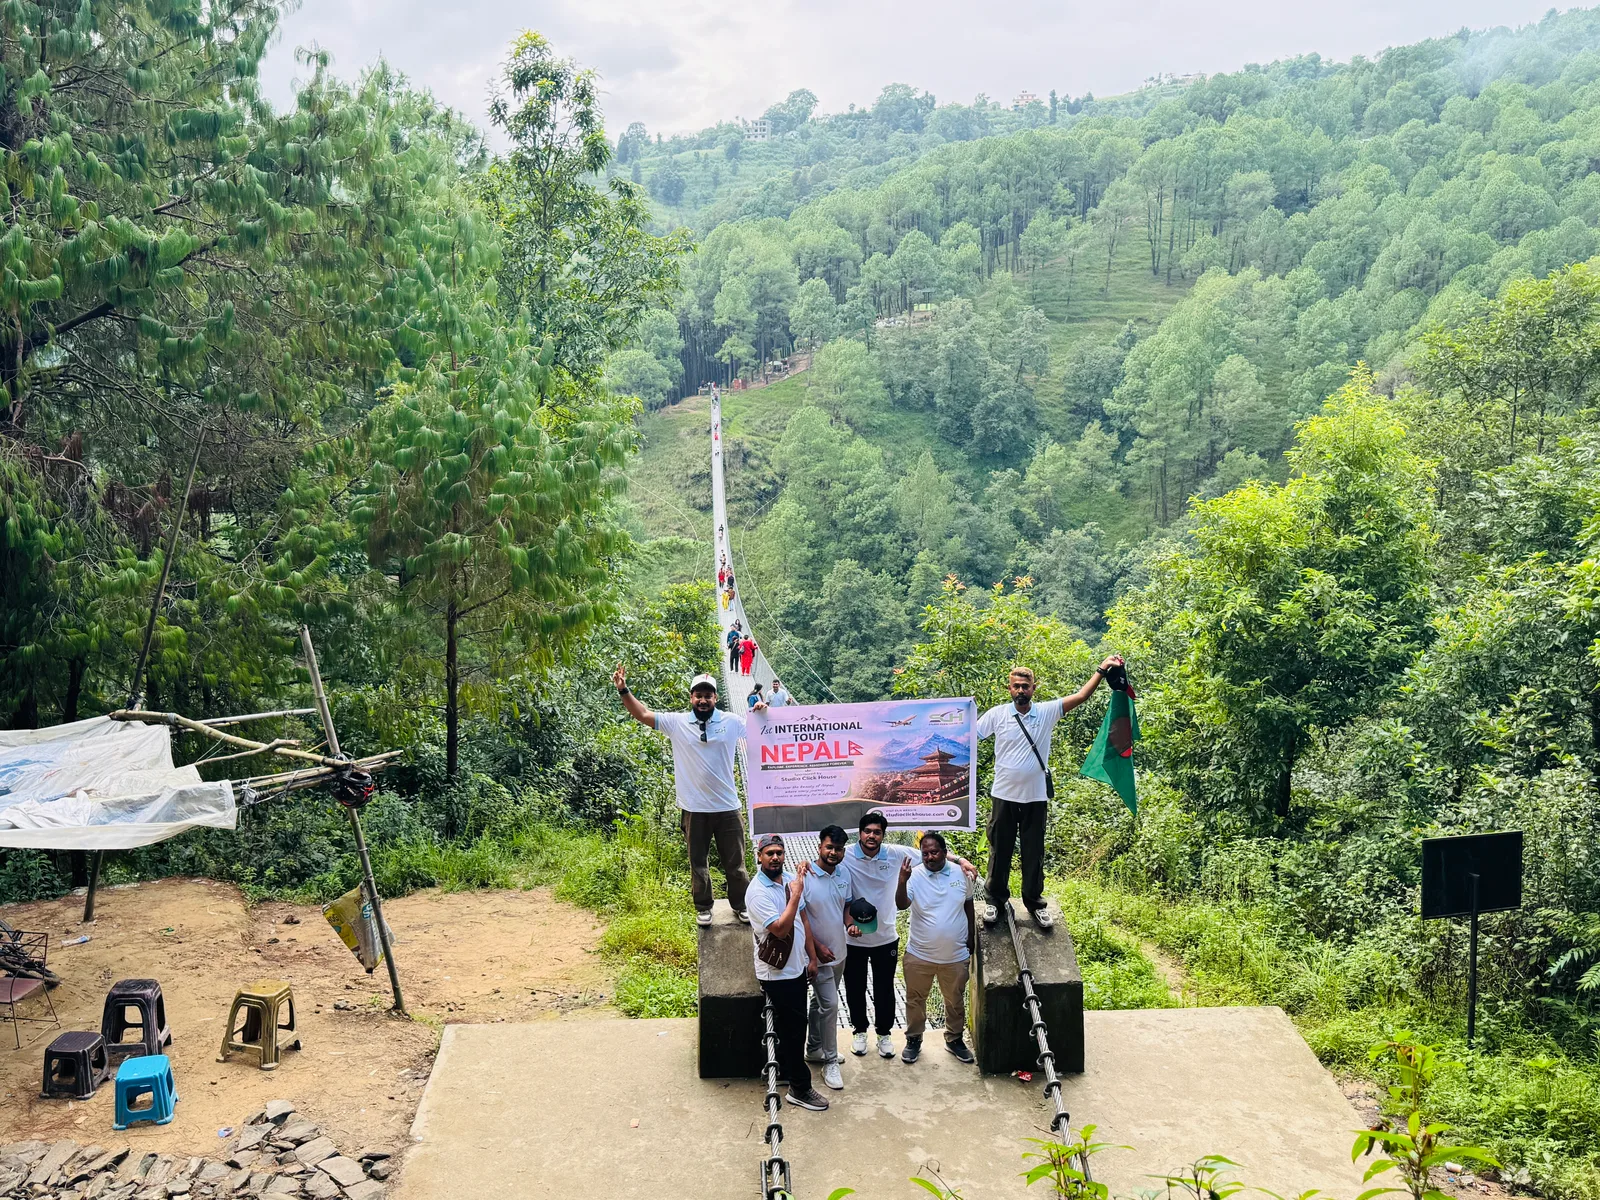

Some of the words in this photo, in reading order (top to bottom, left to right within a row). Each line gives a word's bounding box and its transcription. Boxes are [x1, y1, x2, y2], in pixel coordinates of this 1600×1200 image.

[760, 725, 773, 735] 1st
[775, 722, 862, 734] INTERNATIONAL
[793, 732, 825, 742] TOUR
[761, 741, 848, 762] NEPAL
